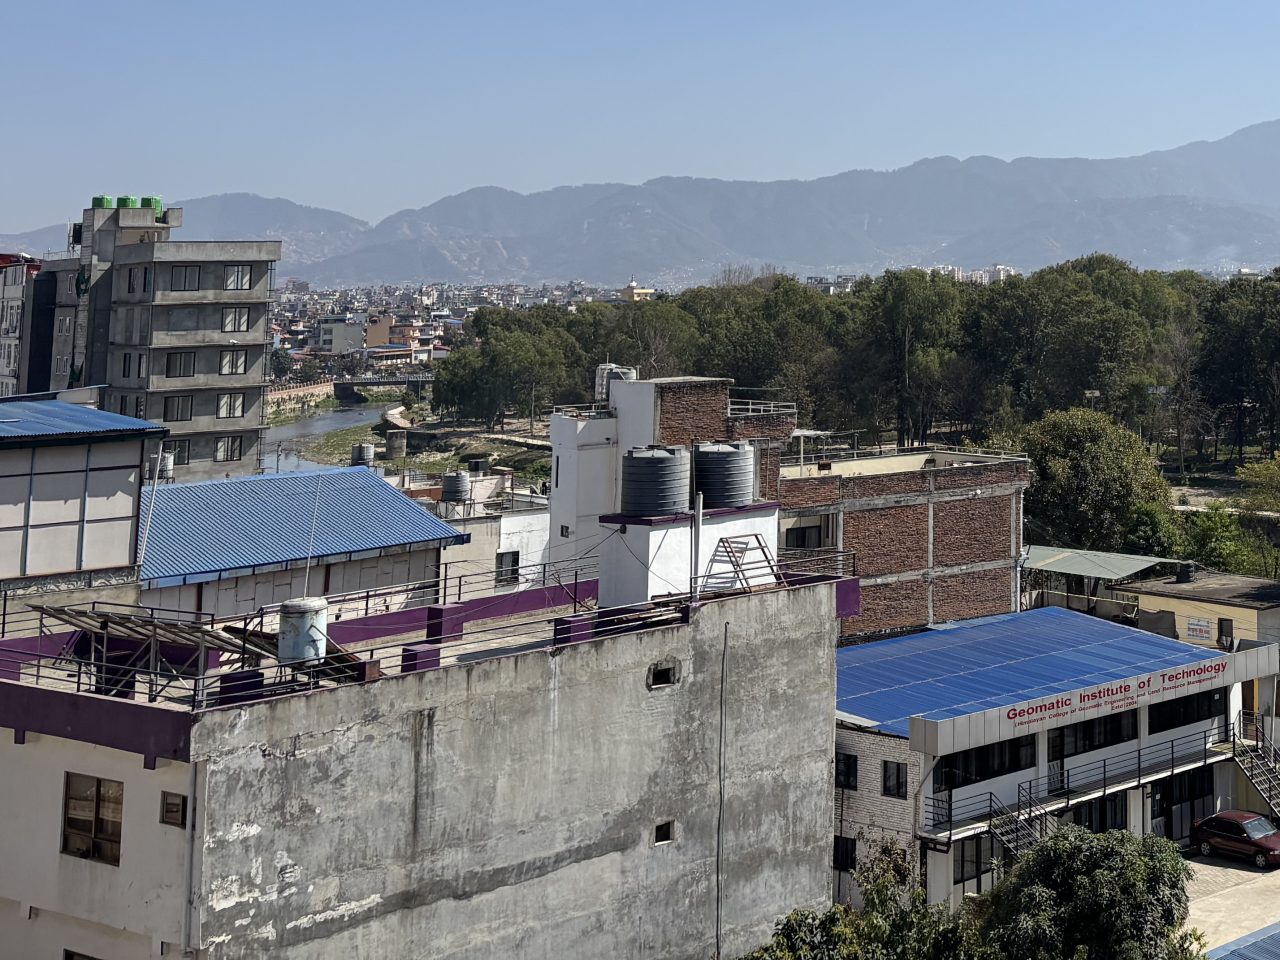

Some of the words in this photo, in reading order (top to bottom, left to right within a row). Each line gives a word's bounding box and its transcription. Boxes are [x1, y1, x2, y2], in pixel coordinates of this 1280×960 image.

[1007, 698, 1072, 720] Geomatic
[1079, 684, 1131, 704] Institute
[1138, 676, 1152, 689] of
[1160, 661, 1228, 683] Technology
[1048, 711, 1069, 720] College
[1078, 701, 1103, 712] Geomatic
[1104, 696, 1135, 706] Engineering
[1162, 683, 1186, 692] Resource
